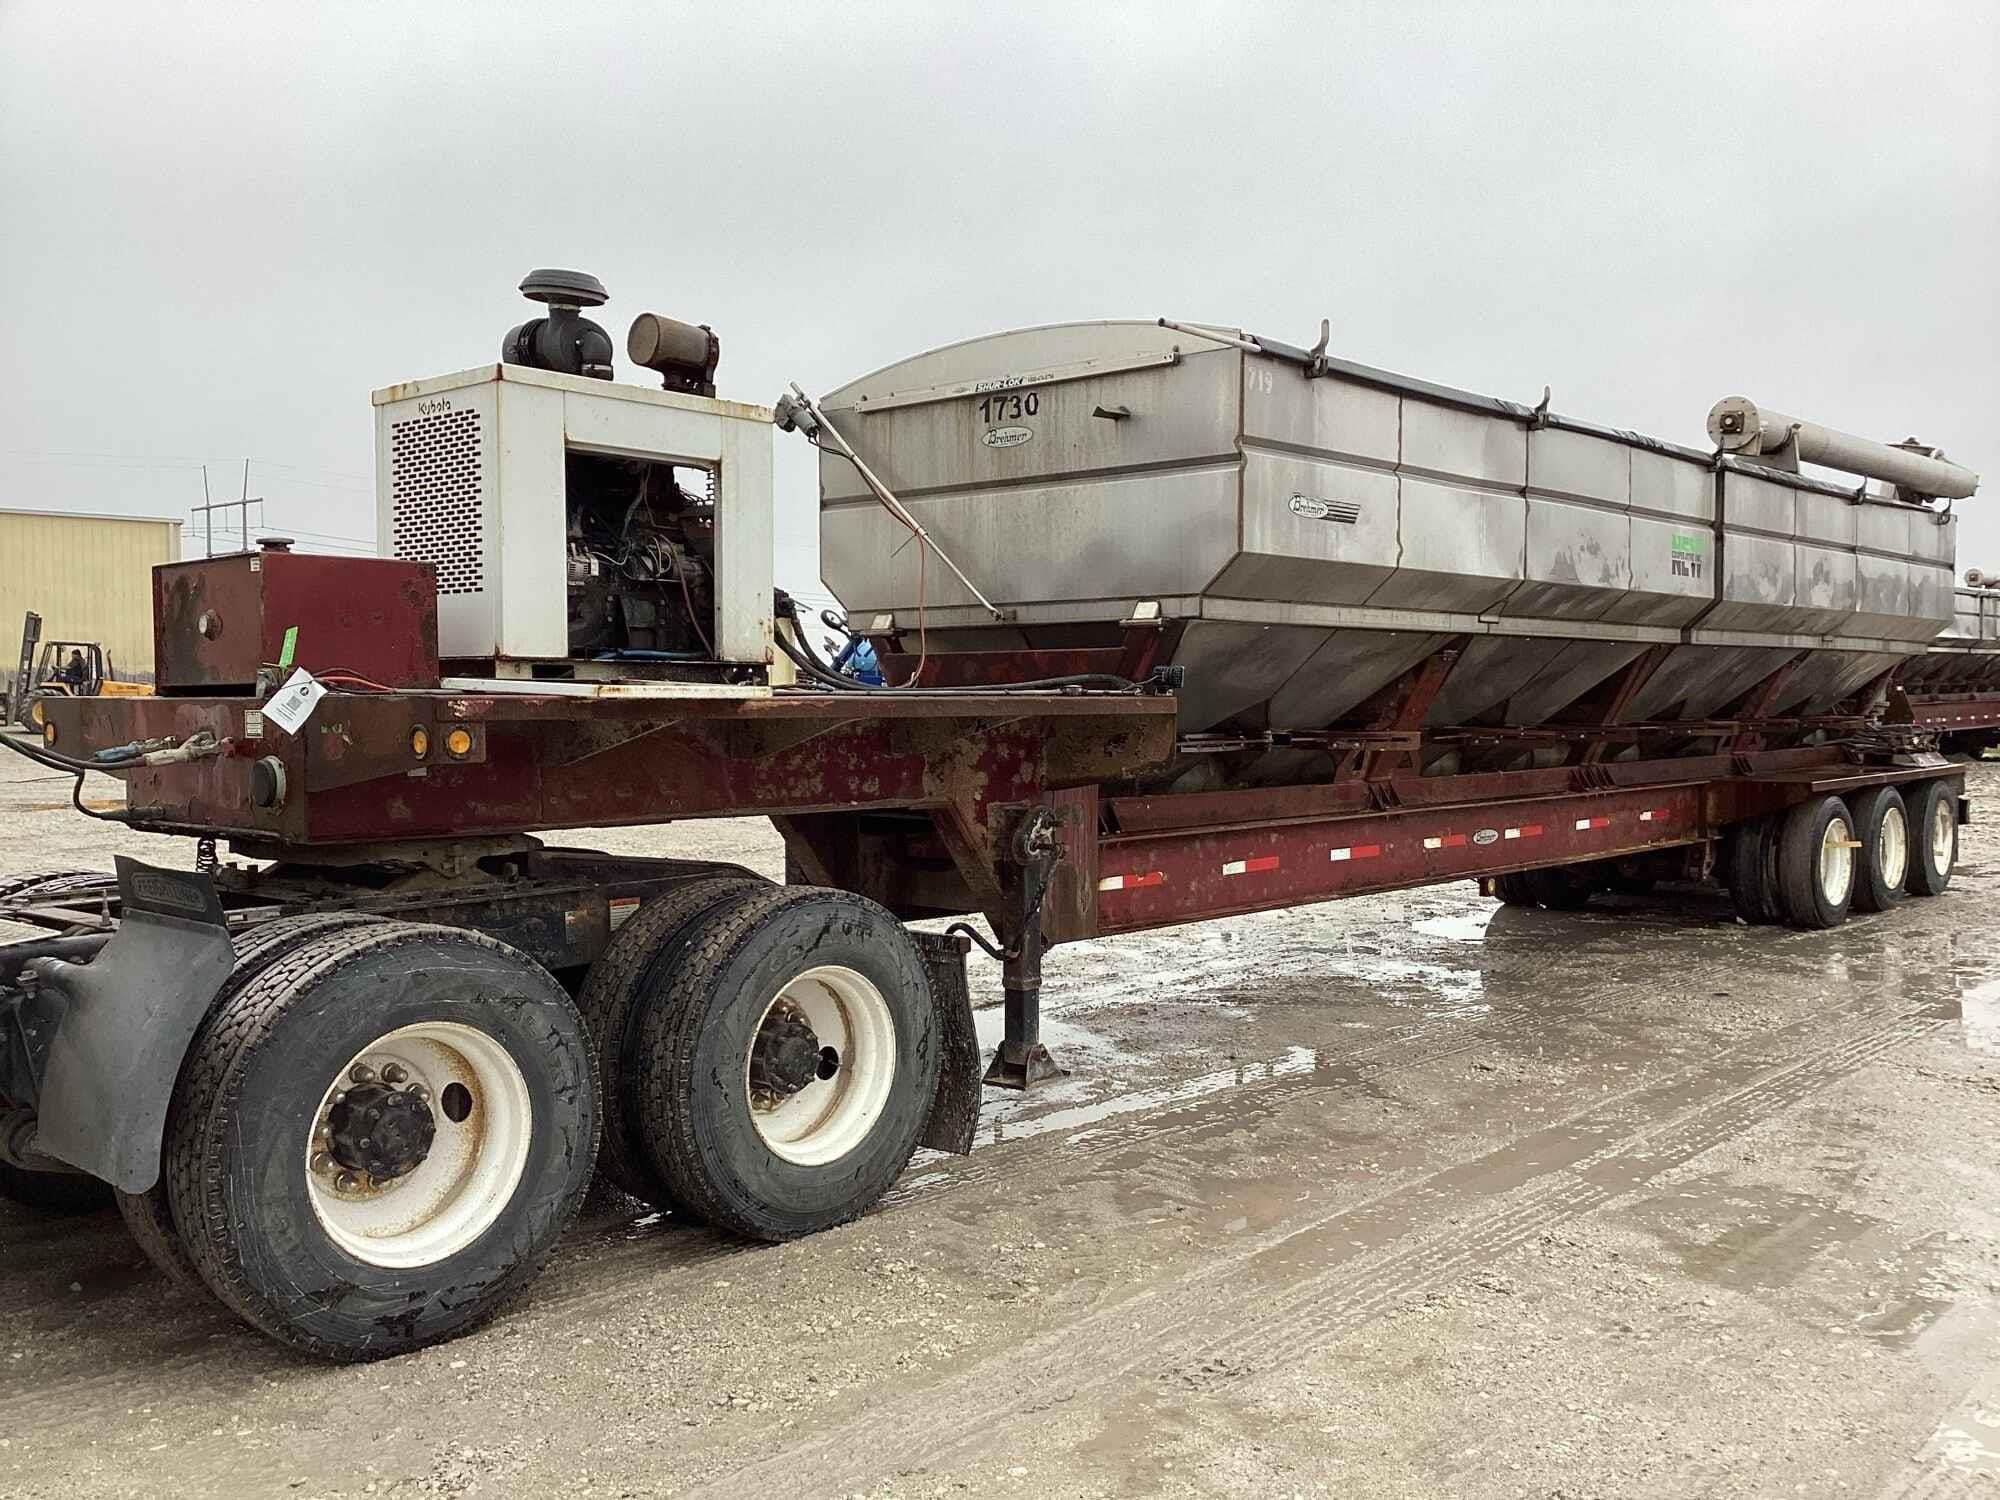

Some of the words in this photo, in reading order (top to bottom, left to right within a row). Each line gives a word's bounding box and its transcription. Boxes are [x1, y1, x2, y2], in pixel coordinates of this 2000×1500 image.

[418, 397, 451, 415] Kubota
[979, 392, 1039, 423] 1730
[987, 429, 1028, 445] Brehmer
